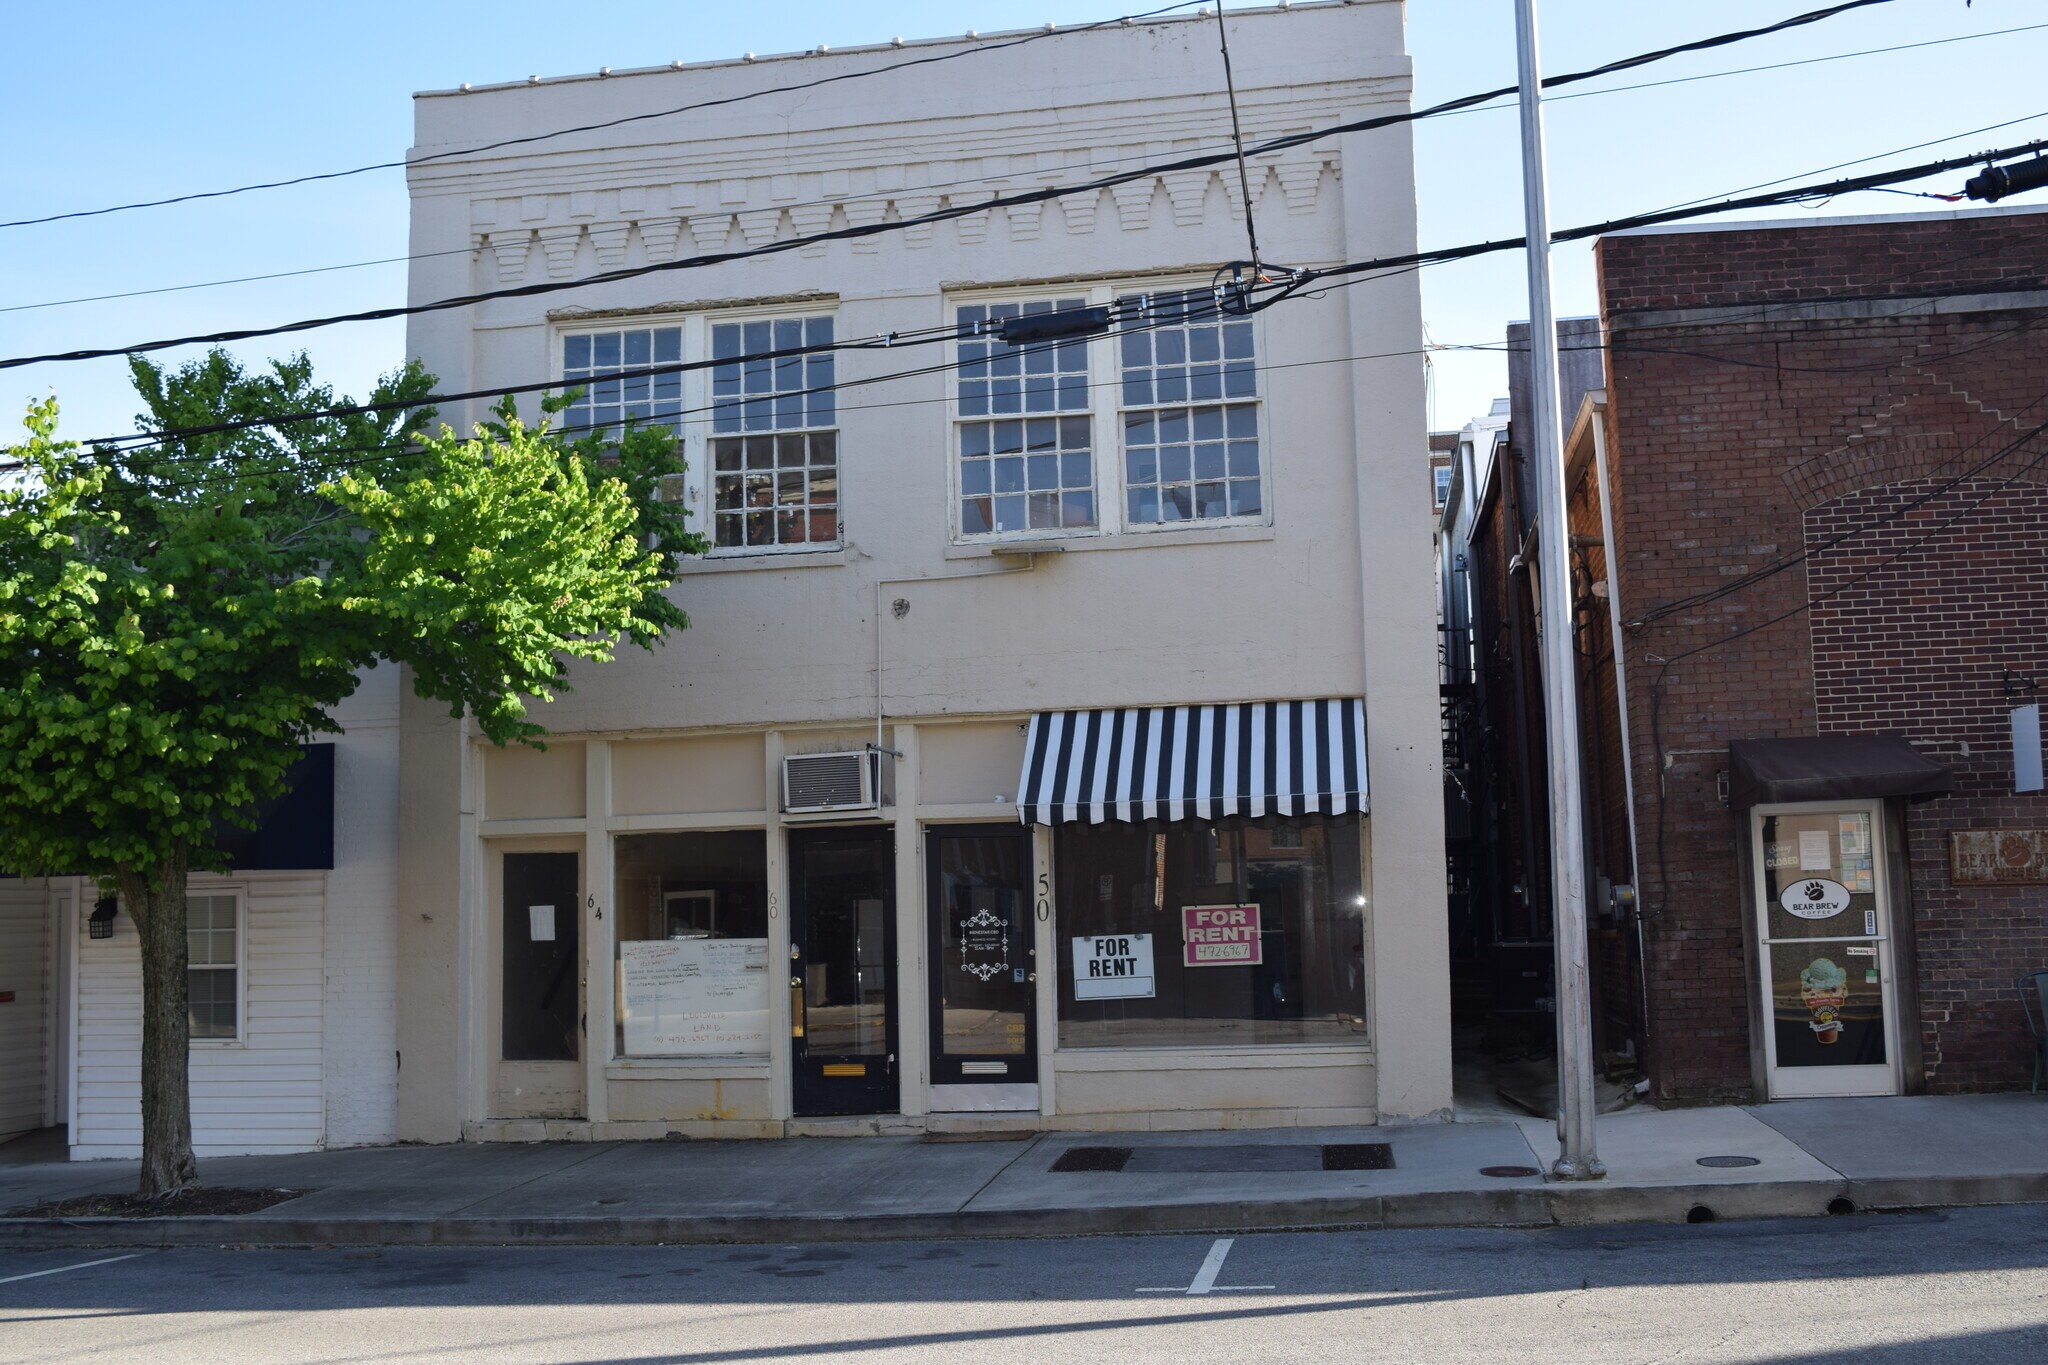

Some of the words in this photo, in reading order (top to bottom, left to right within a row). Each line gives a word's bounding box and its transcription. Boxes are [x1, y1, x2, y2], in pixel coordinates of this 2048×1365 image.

[1766, 856, 1799, 867] CLOSED
[1959, 854, 1998, 868] BEAR
[1037, 873, 1049, 921] 50
[1793, 903, 1814, 911] BEAR
[1816, 902, 1839, 910] BREW
[1196, 910, 1246, 925] FOR
[1188, 926, 1256, 943] RENT
[1095, 938, 1130, 957] FOR
[693, 1024, 721, 1032] LAND
[1007, 1024, 1025, 1032] CBD
